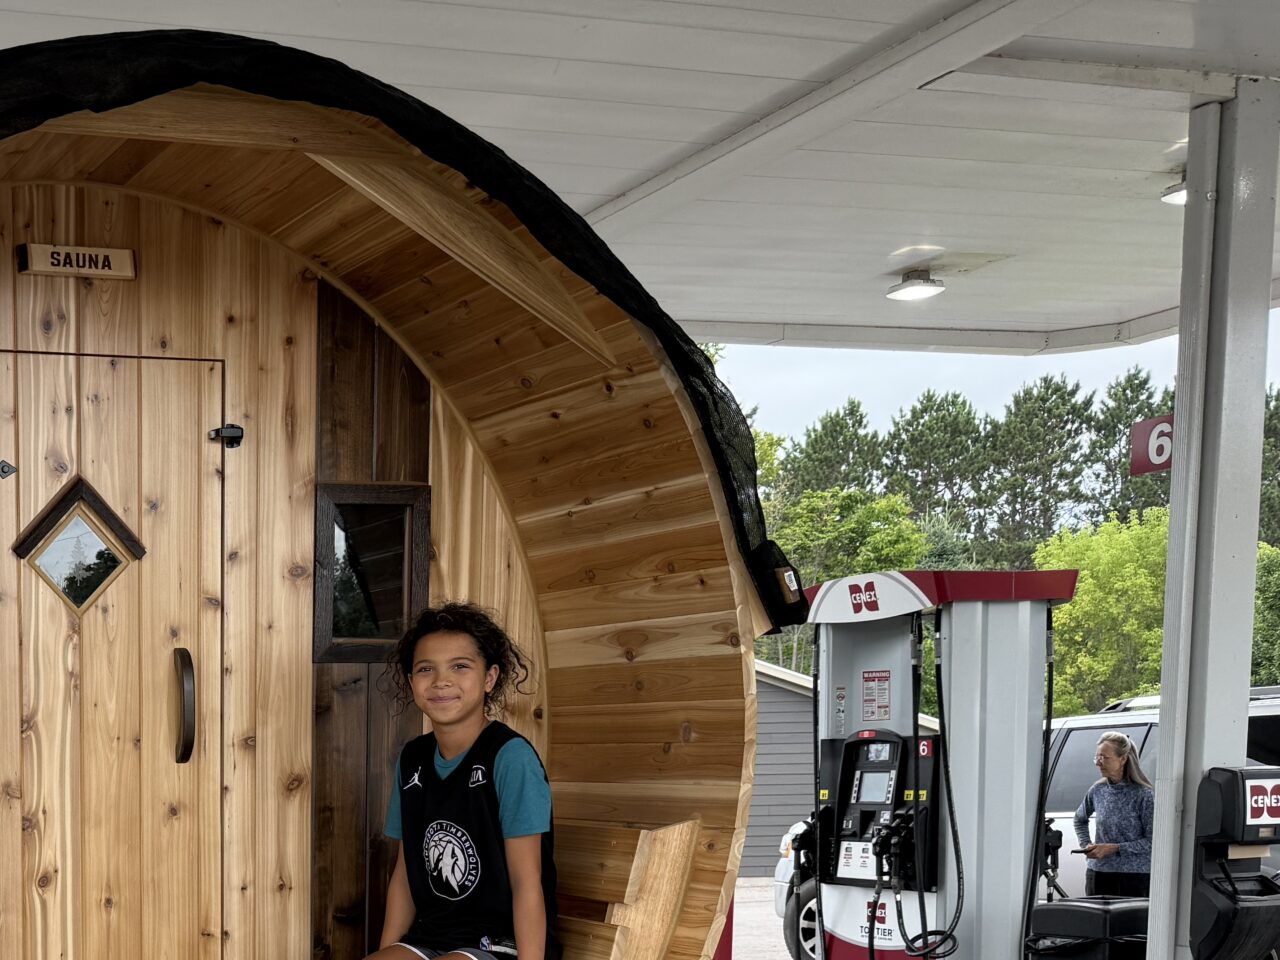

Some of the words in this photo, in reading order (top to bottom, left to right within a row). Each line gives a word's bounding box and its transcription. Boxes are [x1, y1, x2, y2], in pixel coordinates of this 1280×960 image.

[50, 251, 112, 270] SAUNA
[1148, 422, 1173, 465] 6
[851, 591, 877, 604] CENEX
[919, 741, 928, 755] 6
[442, 823, 477, 887] TIMBERWOLVES
[876, 927, 893, 937] TIER
